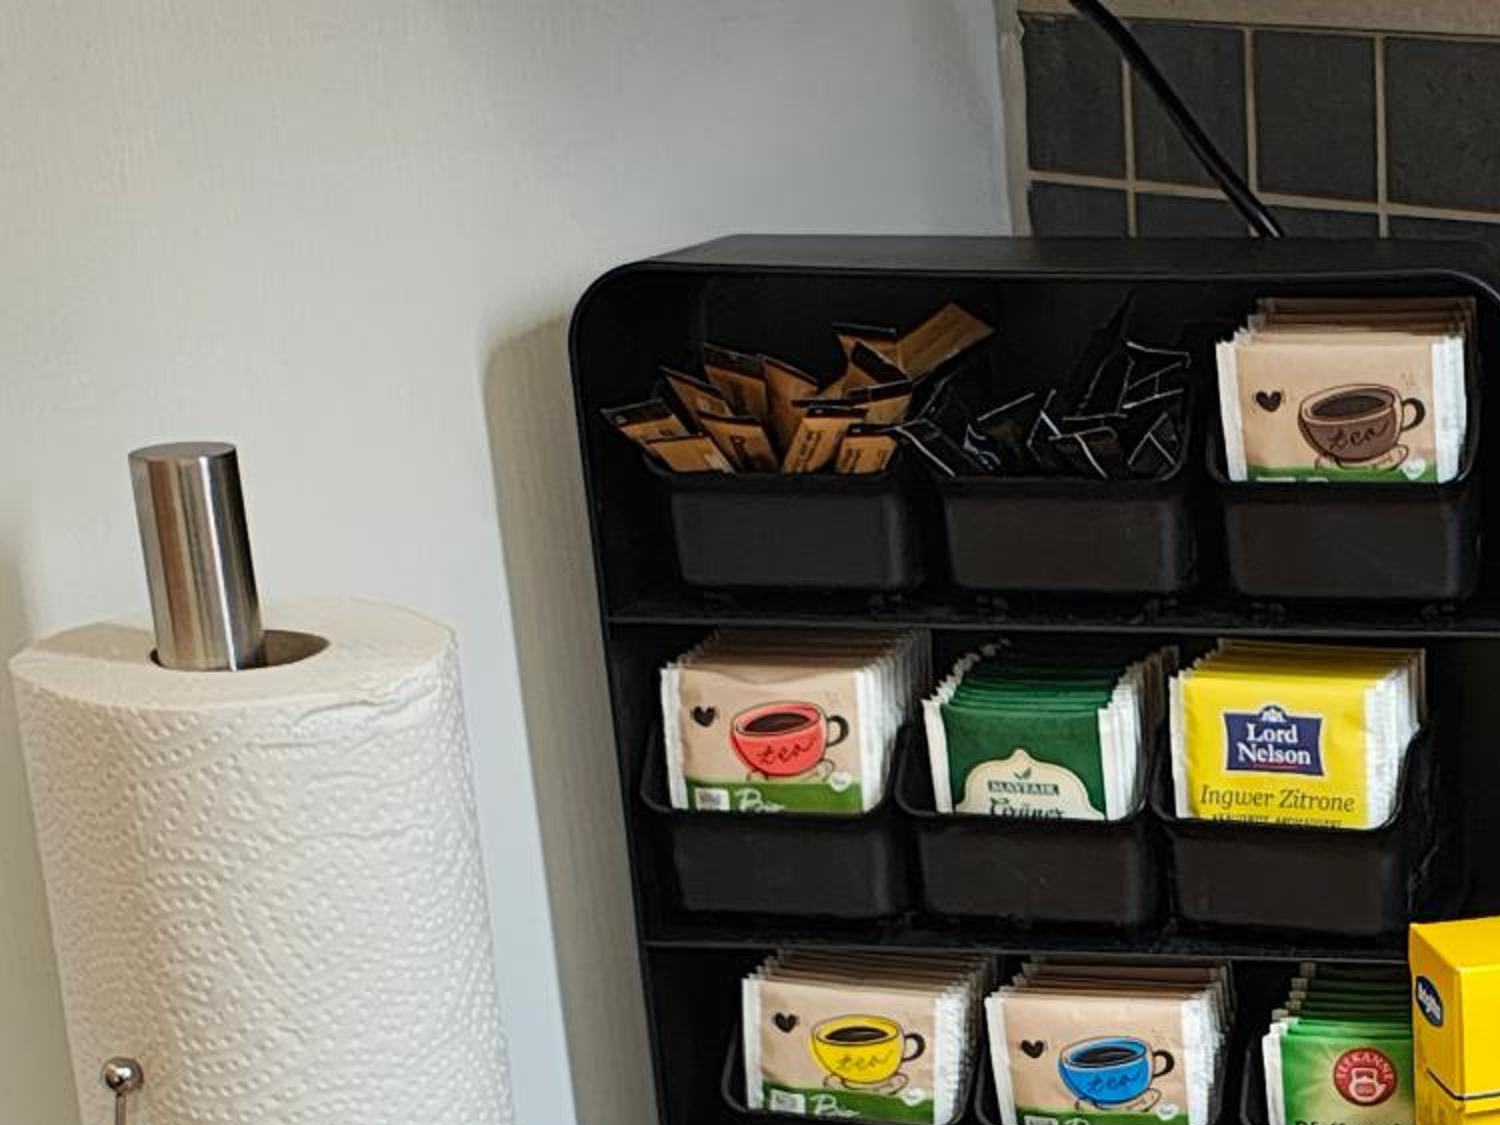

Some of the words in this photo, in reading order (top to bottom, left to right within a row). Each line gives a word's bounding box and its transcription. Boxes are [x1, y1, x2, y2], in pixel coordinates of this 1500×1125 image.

[1247, 723, 1298, 743] Lord
[1237, 742, 1311, 765] Nelson
[1200, 784, 1274, 810] Ingwer
[1279, 789, 1355, 812] Zitrone
